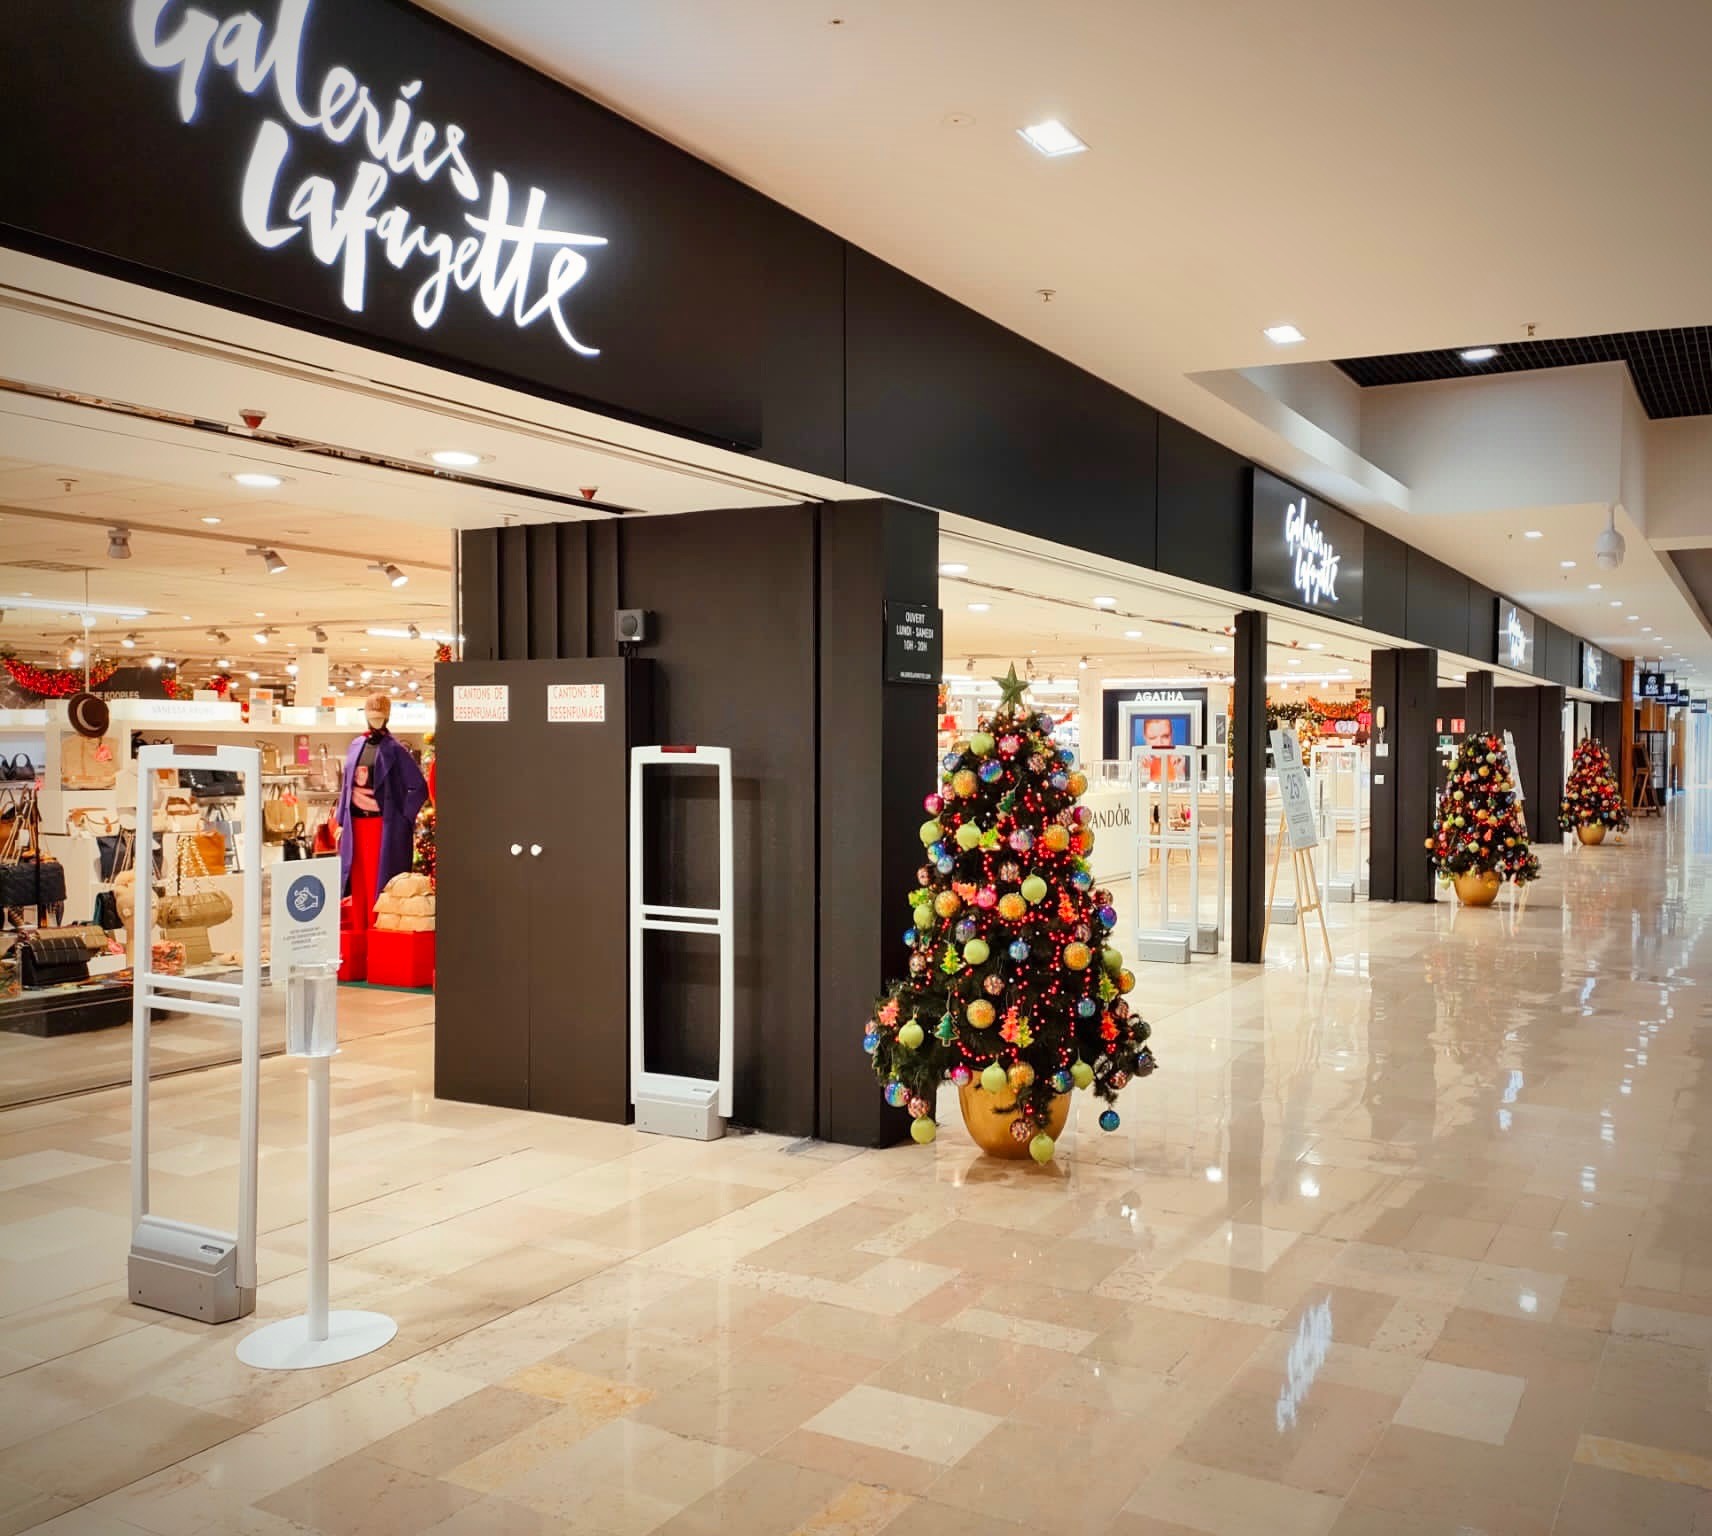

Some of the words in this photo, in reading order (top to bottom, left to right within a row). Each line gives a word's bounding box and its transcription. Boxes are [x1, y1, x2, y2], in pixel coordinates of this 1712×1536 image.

[240, 119, 609, 356] Lafayette
[905, 612, 925, 624] OUVERT
[896, 624, 912, 636] LUNDI
[915, 628, 934, 639] SAMEDI
[903, 640, 914, 651] 10H
[495, 687, 503, 700] DE
[591, 685, 599, 698] DE
[1134, 691, 1185, 703] AGATHA
